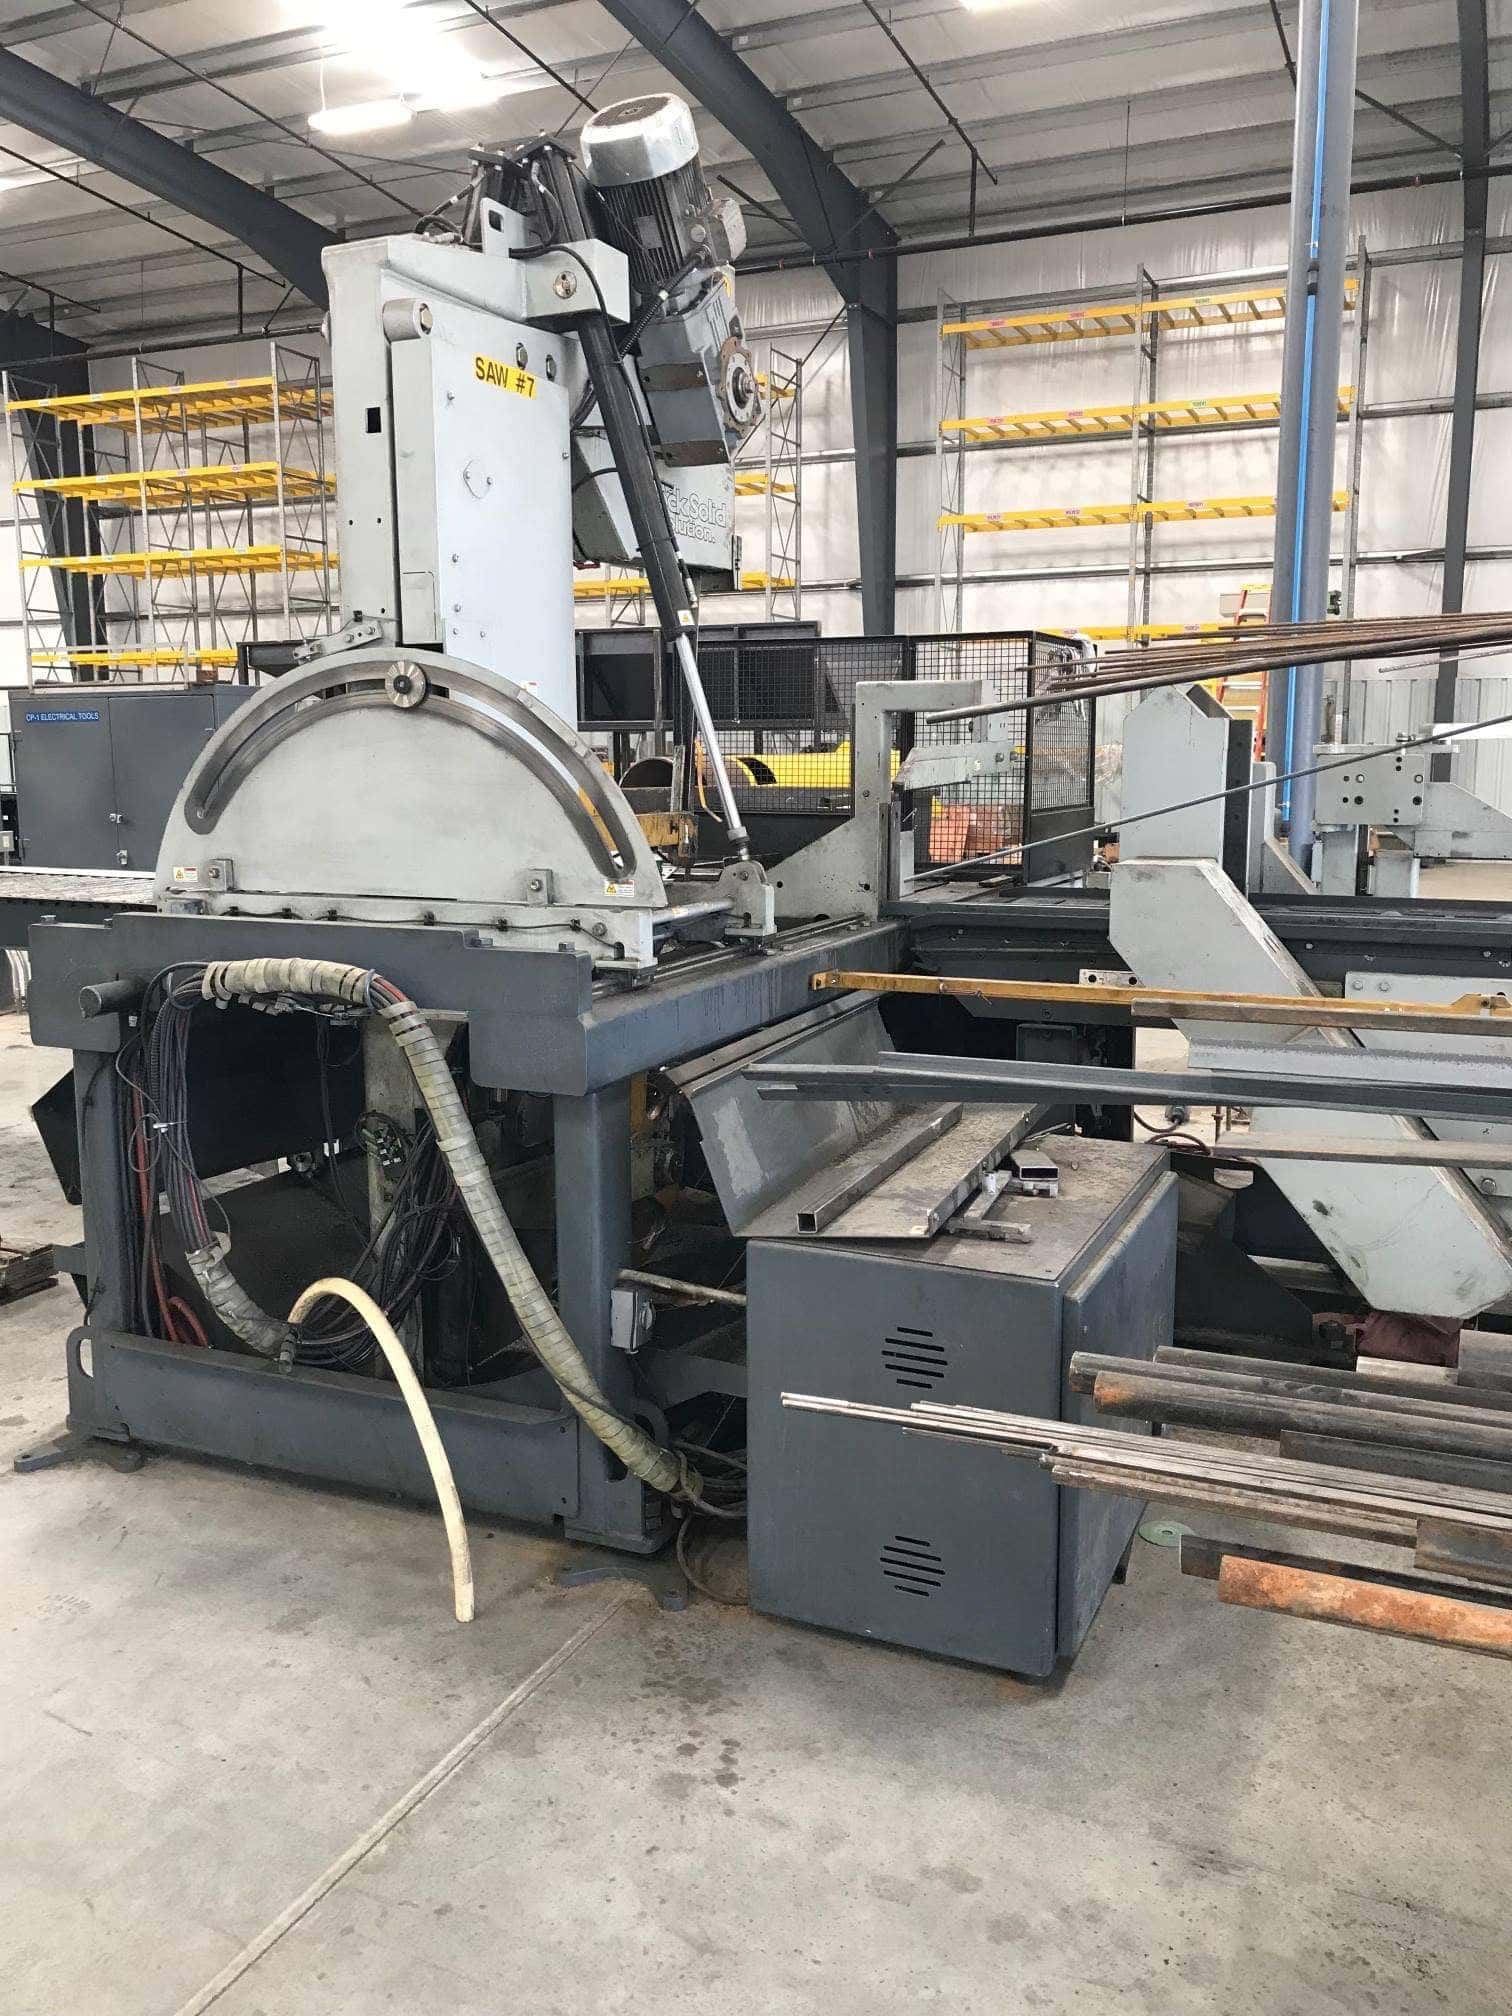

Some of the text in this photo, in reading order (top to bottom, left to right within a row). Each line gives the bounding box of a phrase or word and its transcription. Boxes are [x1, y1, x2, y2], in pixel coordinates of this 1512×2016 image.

[475, 356, 535, 398] SAW #7
[41, 713, 78, 721] ELECTRICAL
[78, 712, 99, 720] TOOLS
